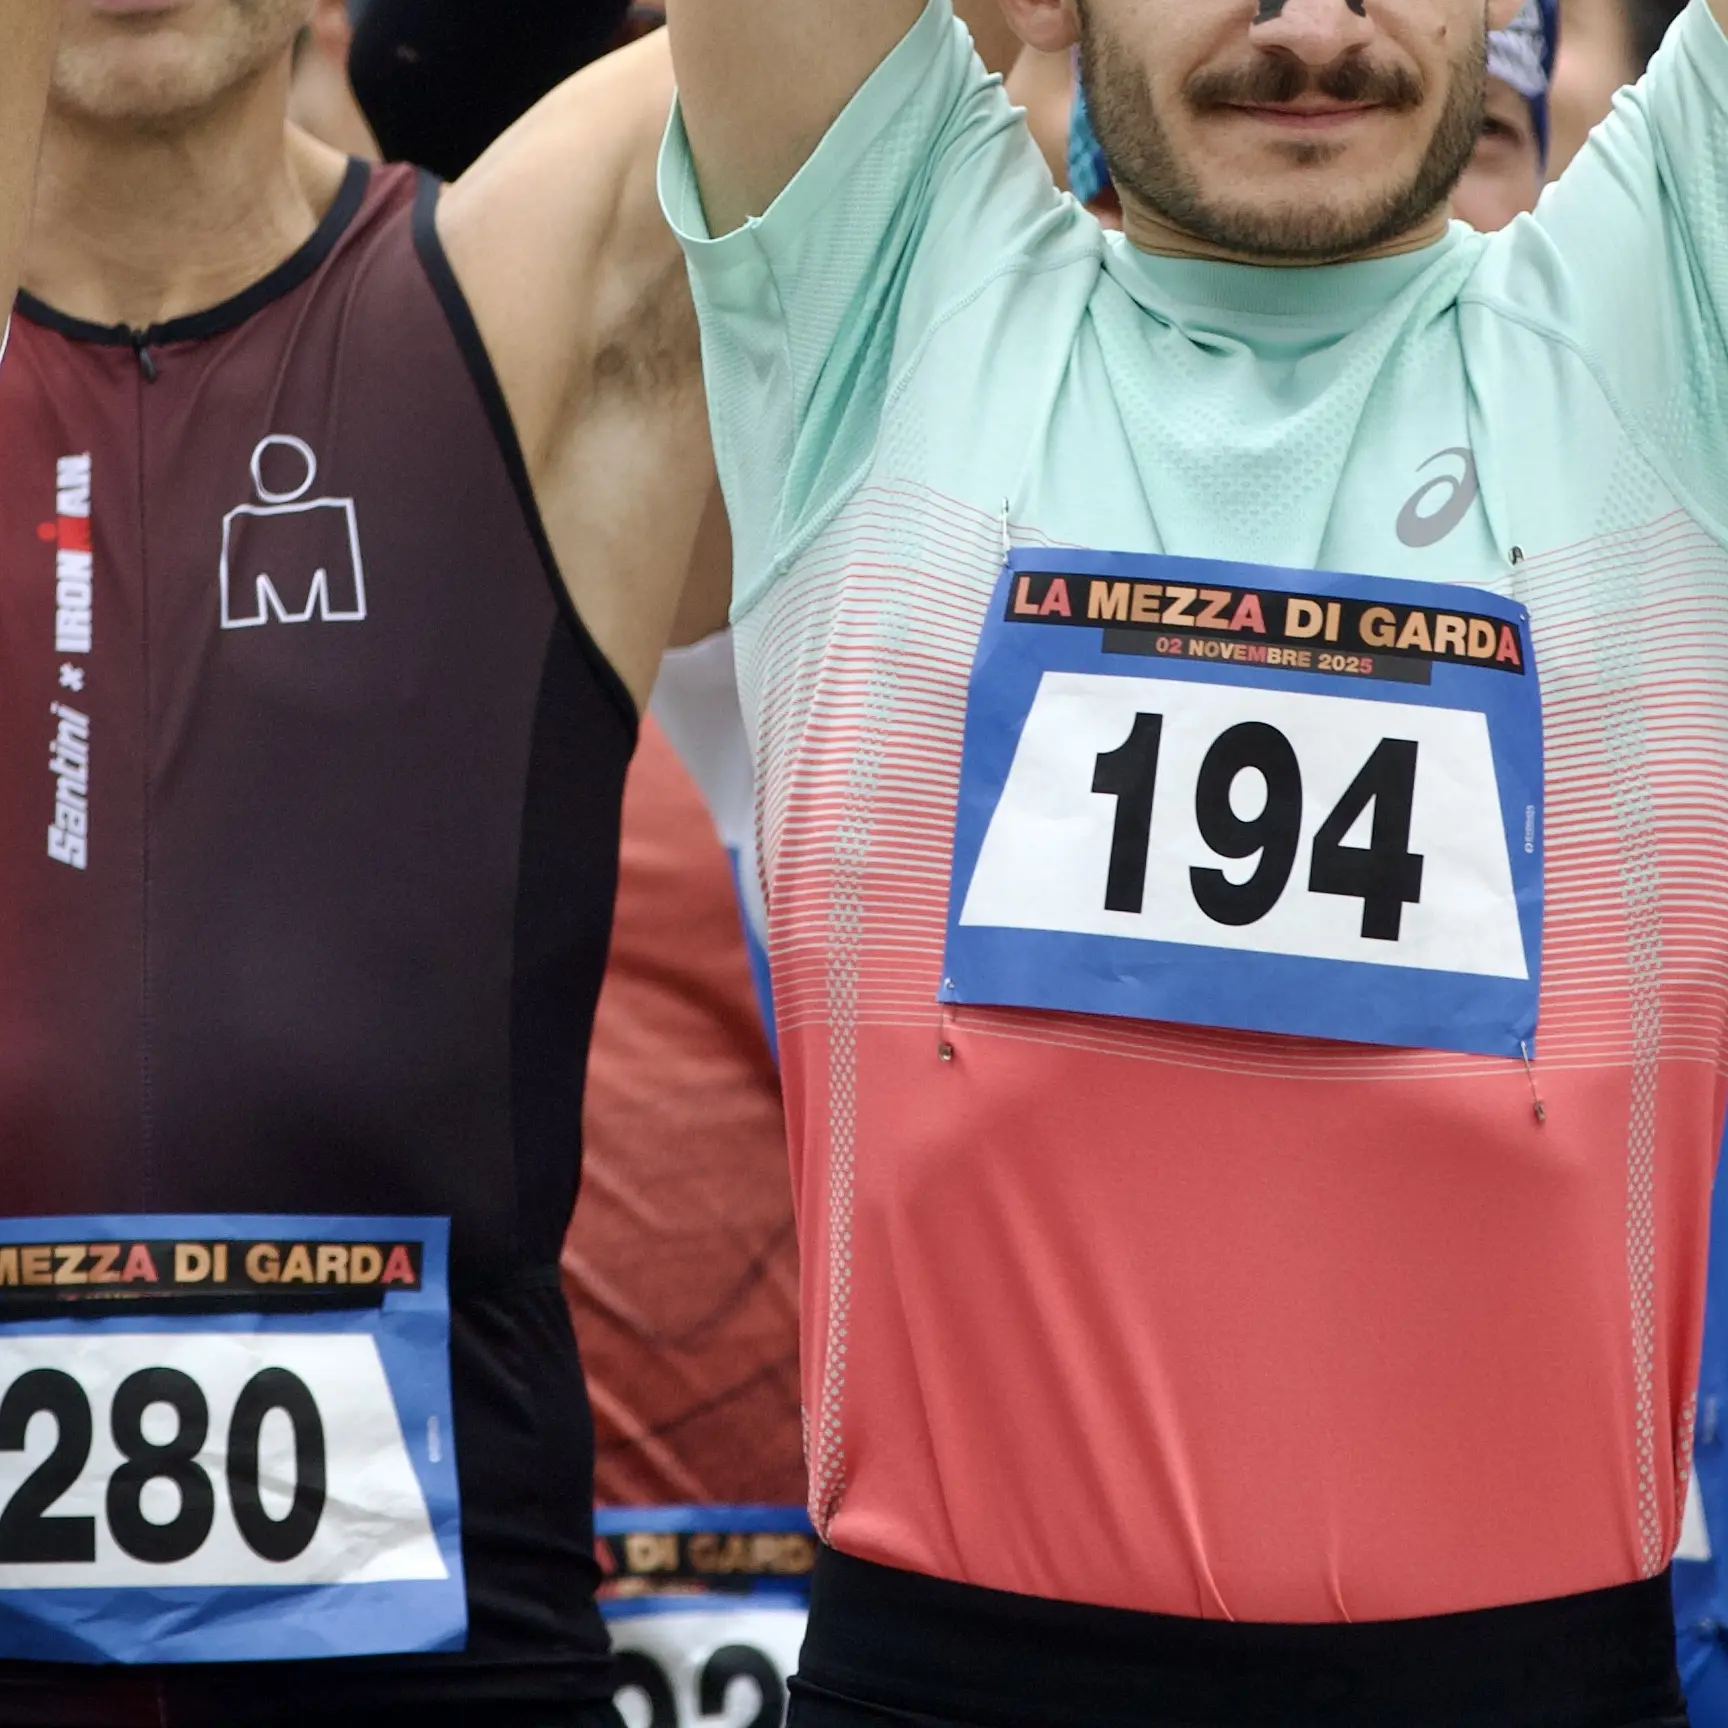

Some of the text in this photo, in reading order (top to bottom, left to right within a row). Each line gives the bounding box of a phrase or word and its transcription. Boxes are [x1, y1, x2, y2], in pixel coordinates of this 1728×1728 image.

[1013, 576, 1521, 667] LA MEZZA DI GARDA
[1155, 635, 1374, 675] 02 NOVEMBRE 2025
[47, 701, 90, 872] Santini
[1090, 711, 1425, 943] 194
[174, 1243, 227, 1285] DI
[245, 1243, 417, 1286] GARDA
